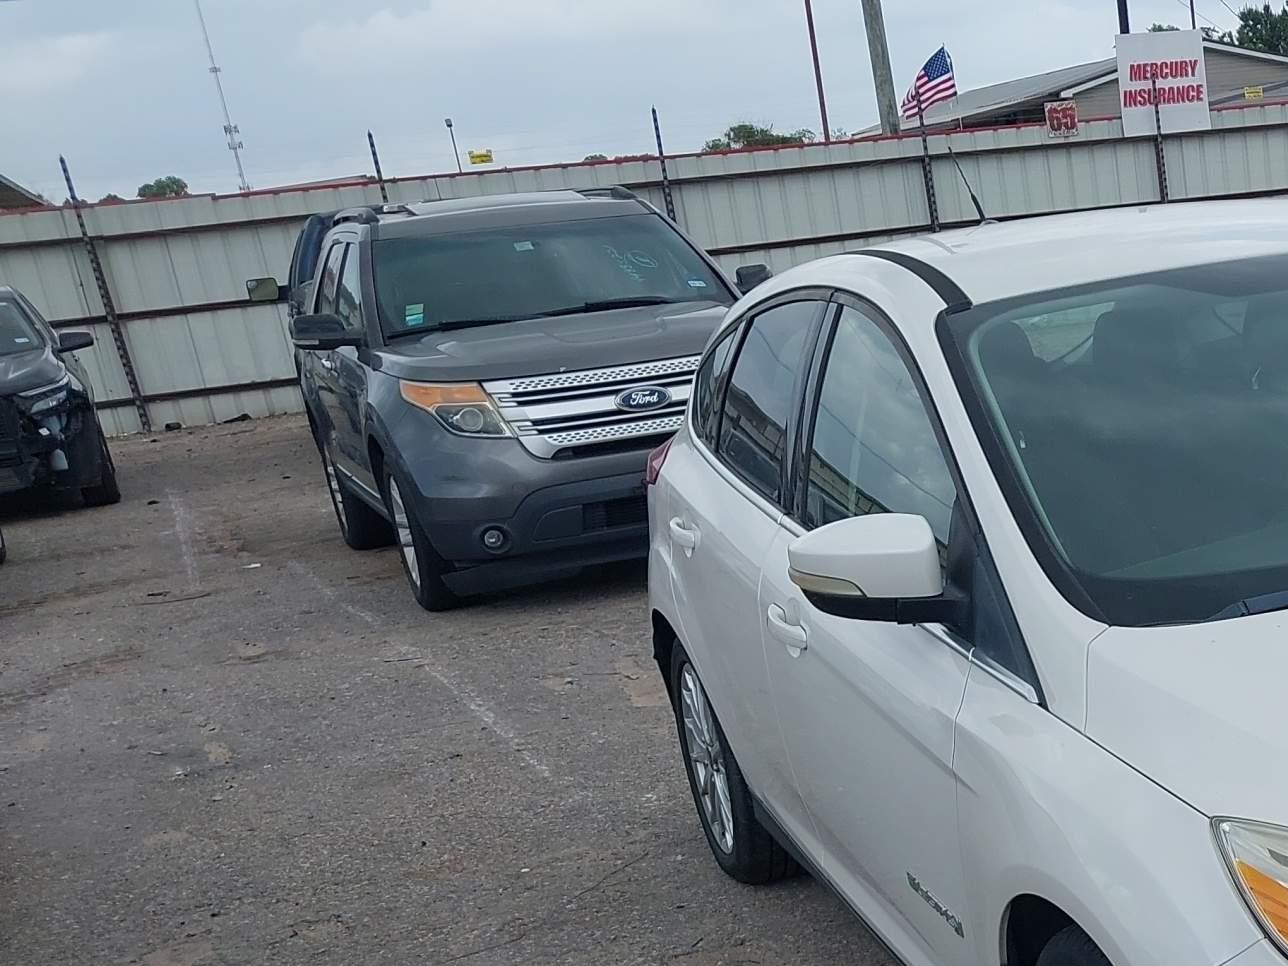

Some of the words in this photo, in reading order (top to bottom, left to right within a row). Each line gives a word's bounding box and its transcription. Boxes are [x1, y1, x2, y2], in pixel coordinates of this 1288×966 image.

[1129, 59, 1198, 82] MERCURY
[1123, 84, 1204, 108] INSURANCE
[1047, 104, 1077, 131] 65
[630, 391, 659, 405] Ford
